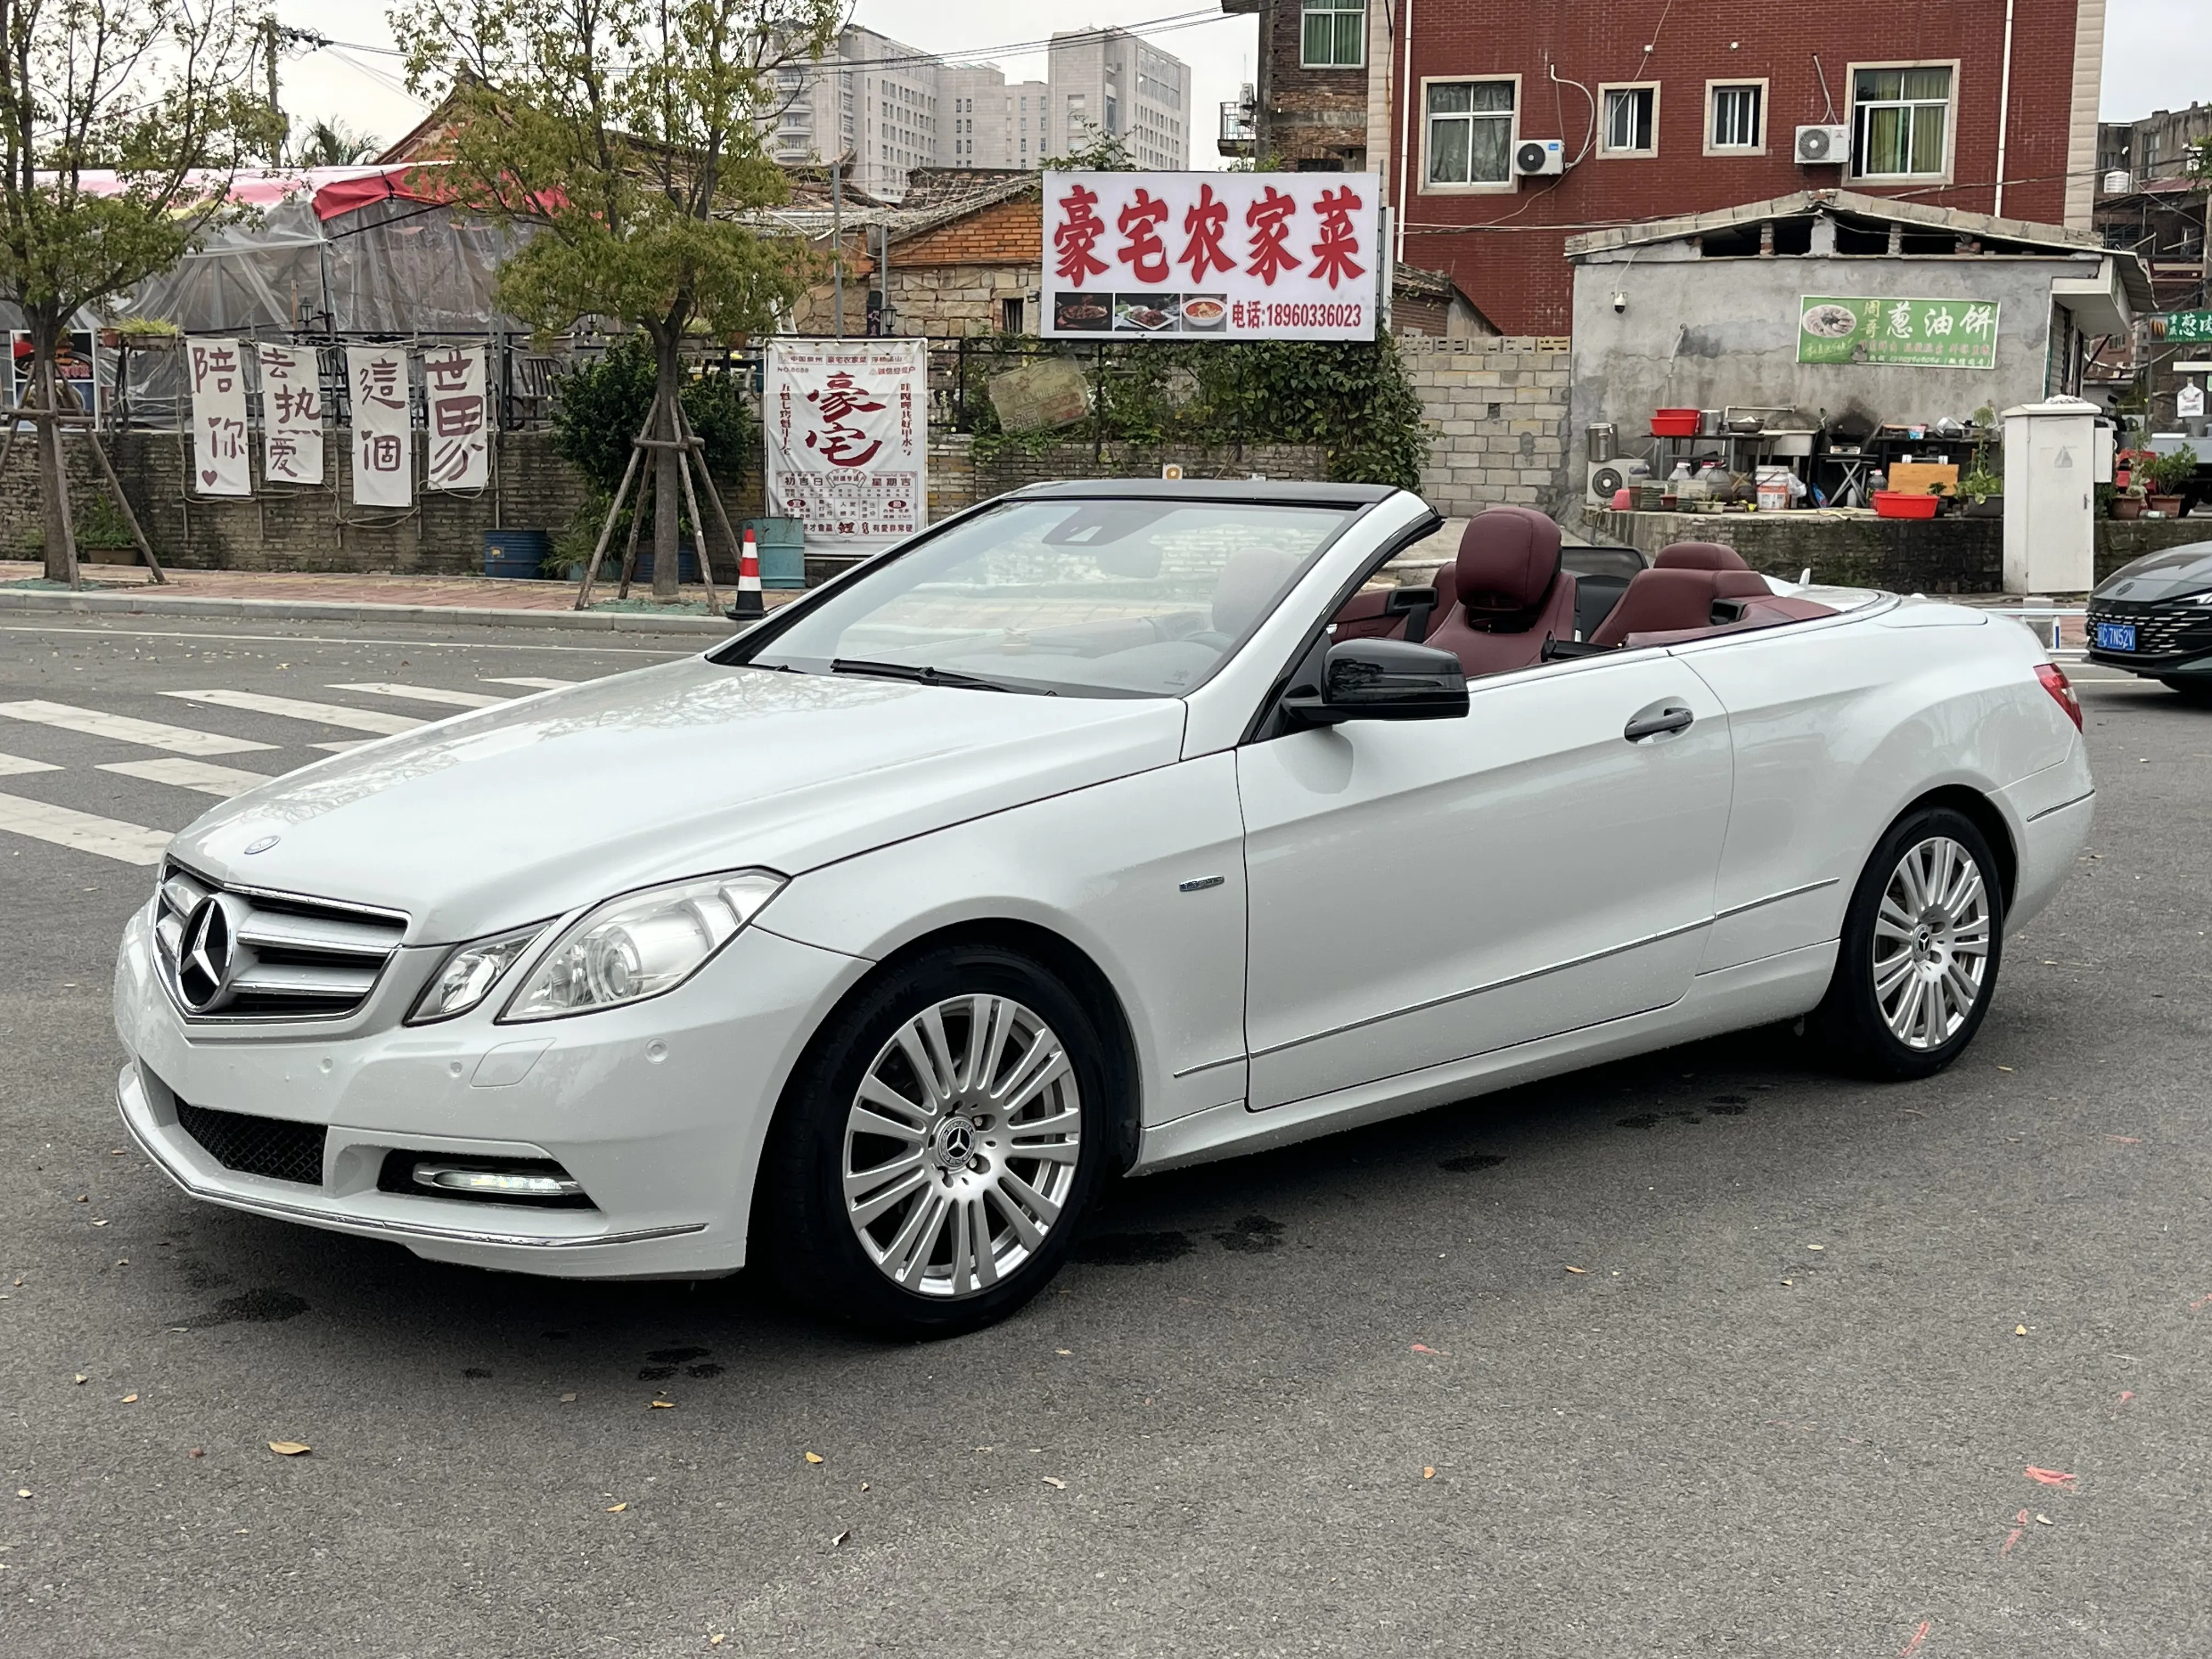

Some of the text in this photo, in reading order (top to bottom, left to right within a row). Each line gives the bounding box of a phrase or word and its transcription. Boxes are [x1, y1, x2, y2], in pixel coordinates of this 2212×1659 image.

[1054, 184, 1367, 290] 豪宅农家菜
[1887, 301, 1994, 341] 葱油饼
[193, 347, 244, 459] 陪你
[425, 350, 484, 481] 世界
[805, 371, 887, 467] 豪宅
